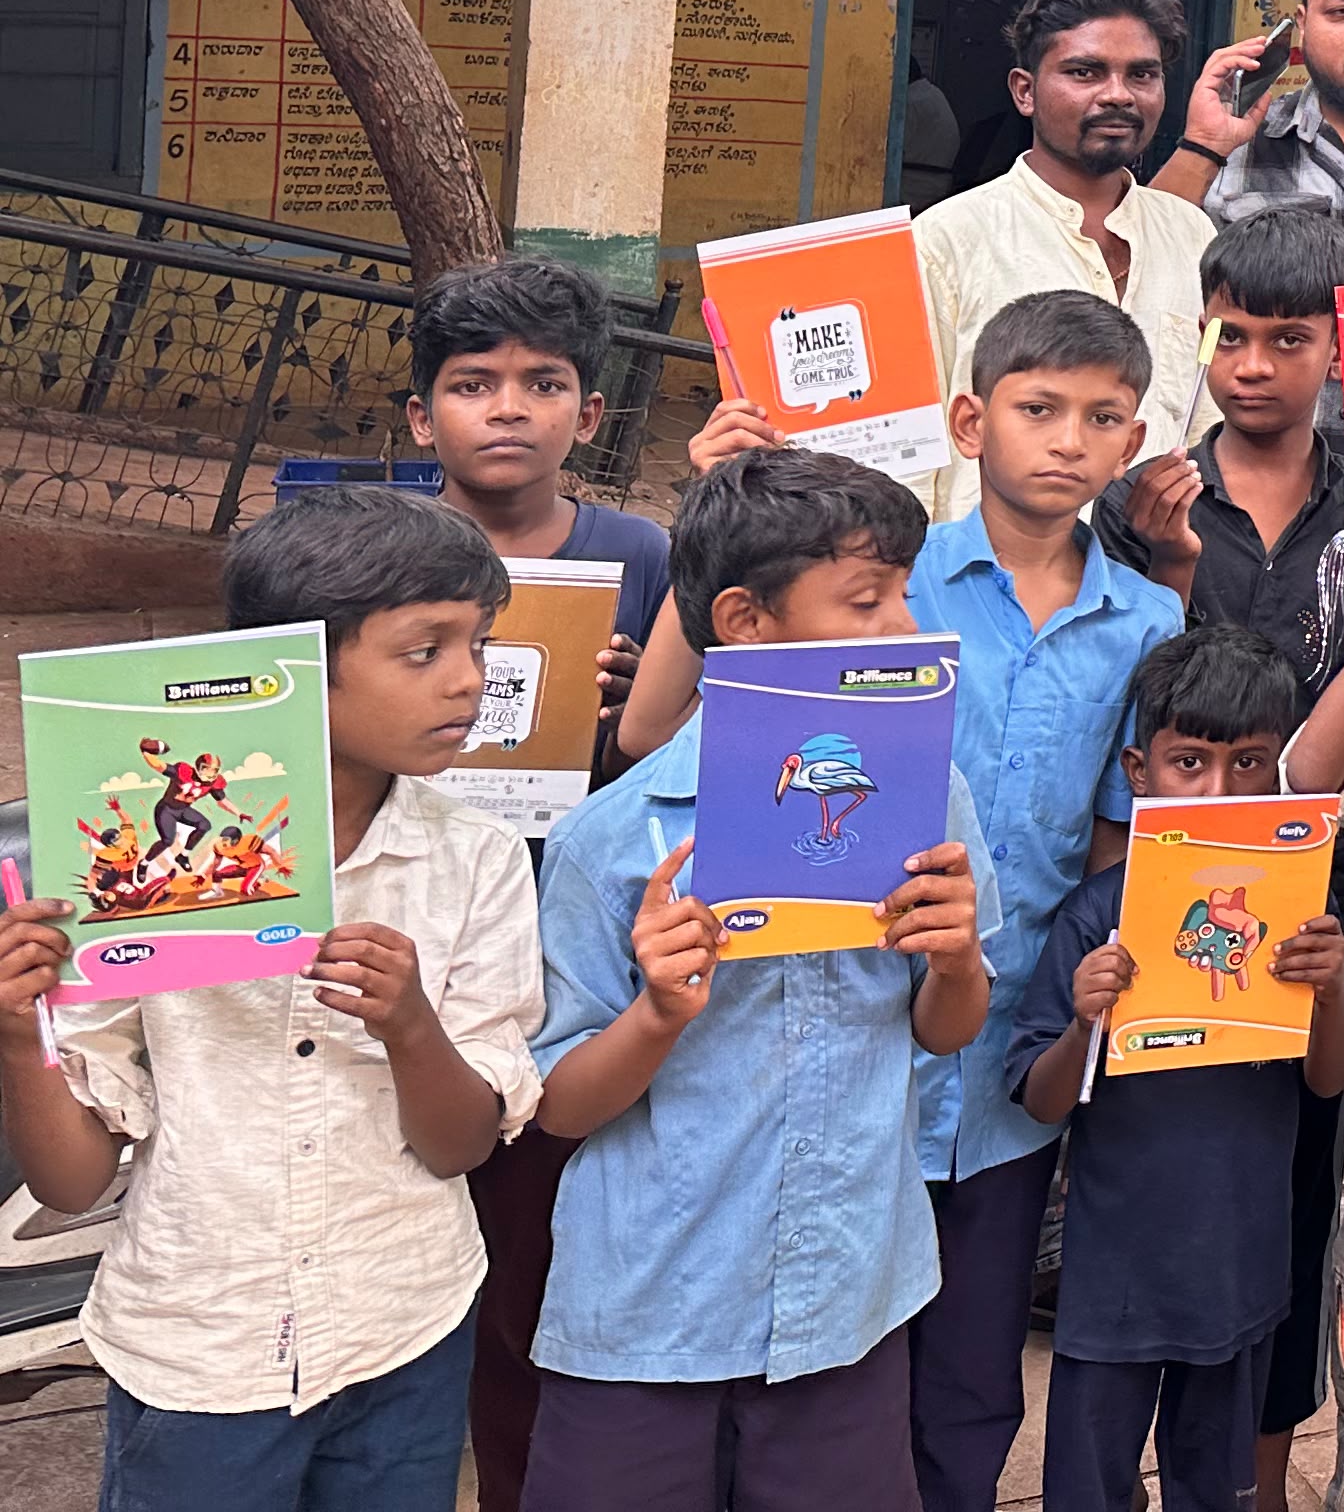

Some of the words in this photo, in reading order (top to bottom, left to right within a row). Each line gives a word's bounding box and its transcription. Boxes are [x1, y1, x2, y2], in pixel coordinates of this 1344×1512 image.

[172, 42, 192, 66] 4
[201, 43, 265, 58] ಗುರುವಾರ
[289, 62, 335, 77] ತರಕಾ
[168, 88, 189, 113] 5
[166, 133, 185, 159] 6
[795, 323, 846, 354] MAKE
[794, 369, 825, 386] COME
[826, 364, 855, 382] TRUE
[490, 665, 517, 678] YOUR
[843, 668, 914, 685] Brilliance
[166, 679, 250, 701] Brilliance
[484, 681, 516, 698] EAMS
[1161, 832, 1184, 842] GOLD
[1276, 824, 1310, 838] Ajay
[727, 912, 767, 928] Ajay
[260, 928, 297, 943] GOLD
[104, 944, 150, 964] Ajay
[1146, 1032, 1204, 1047] Brilliance
